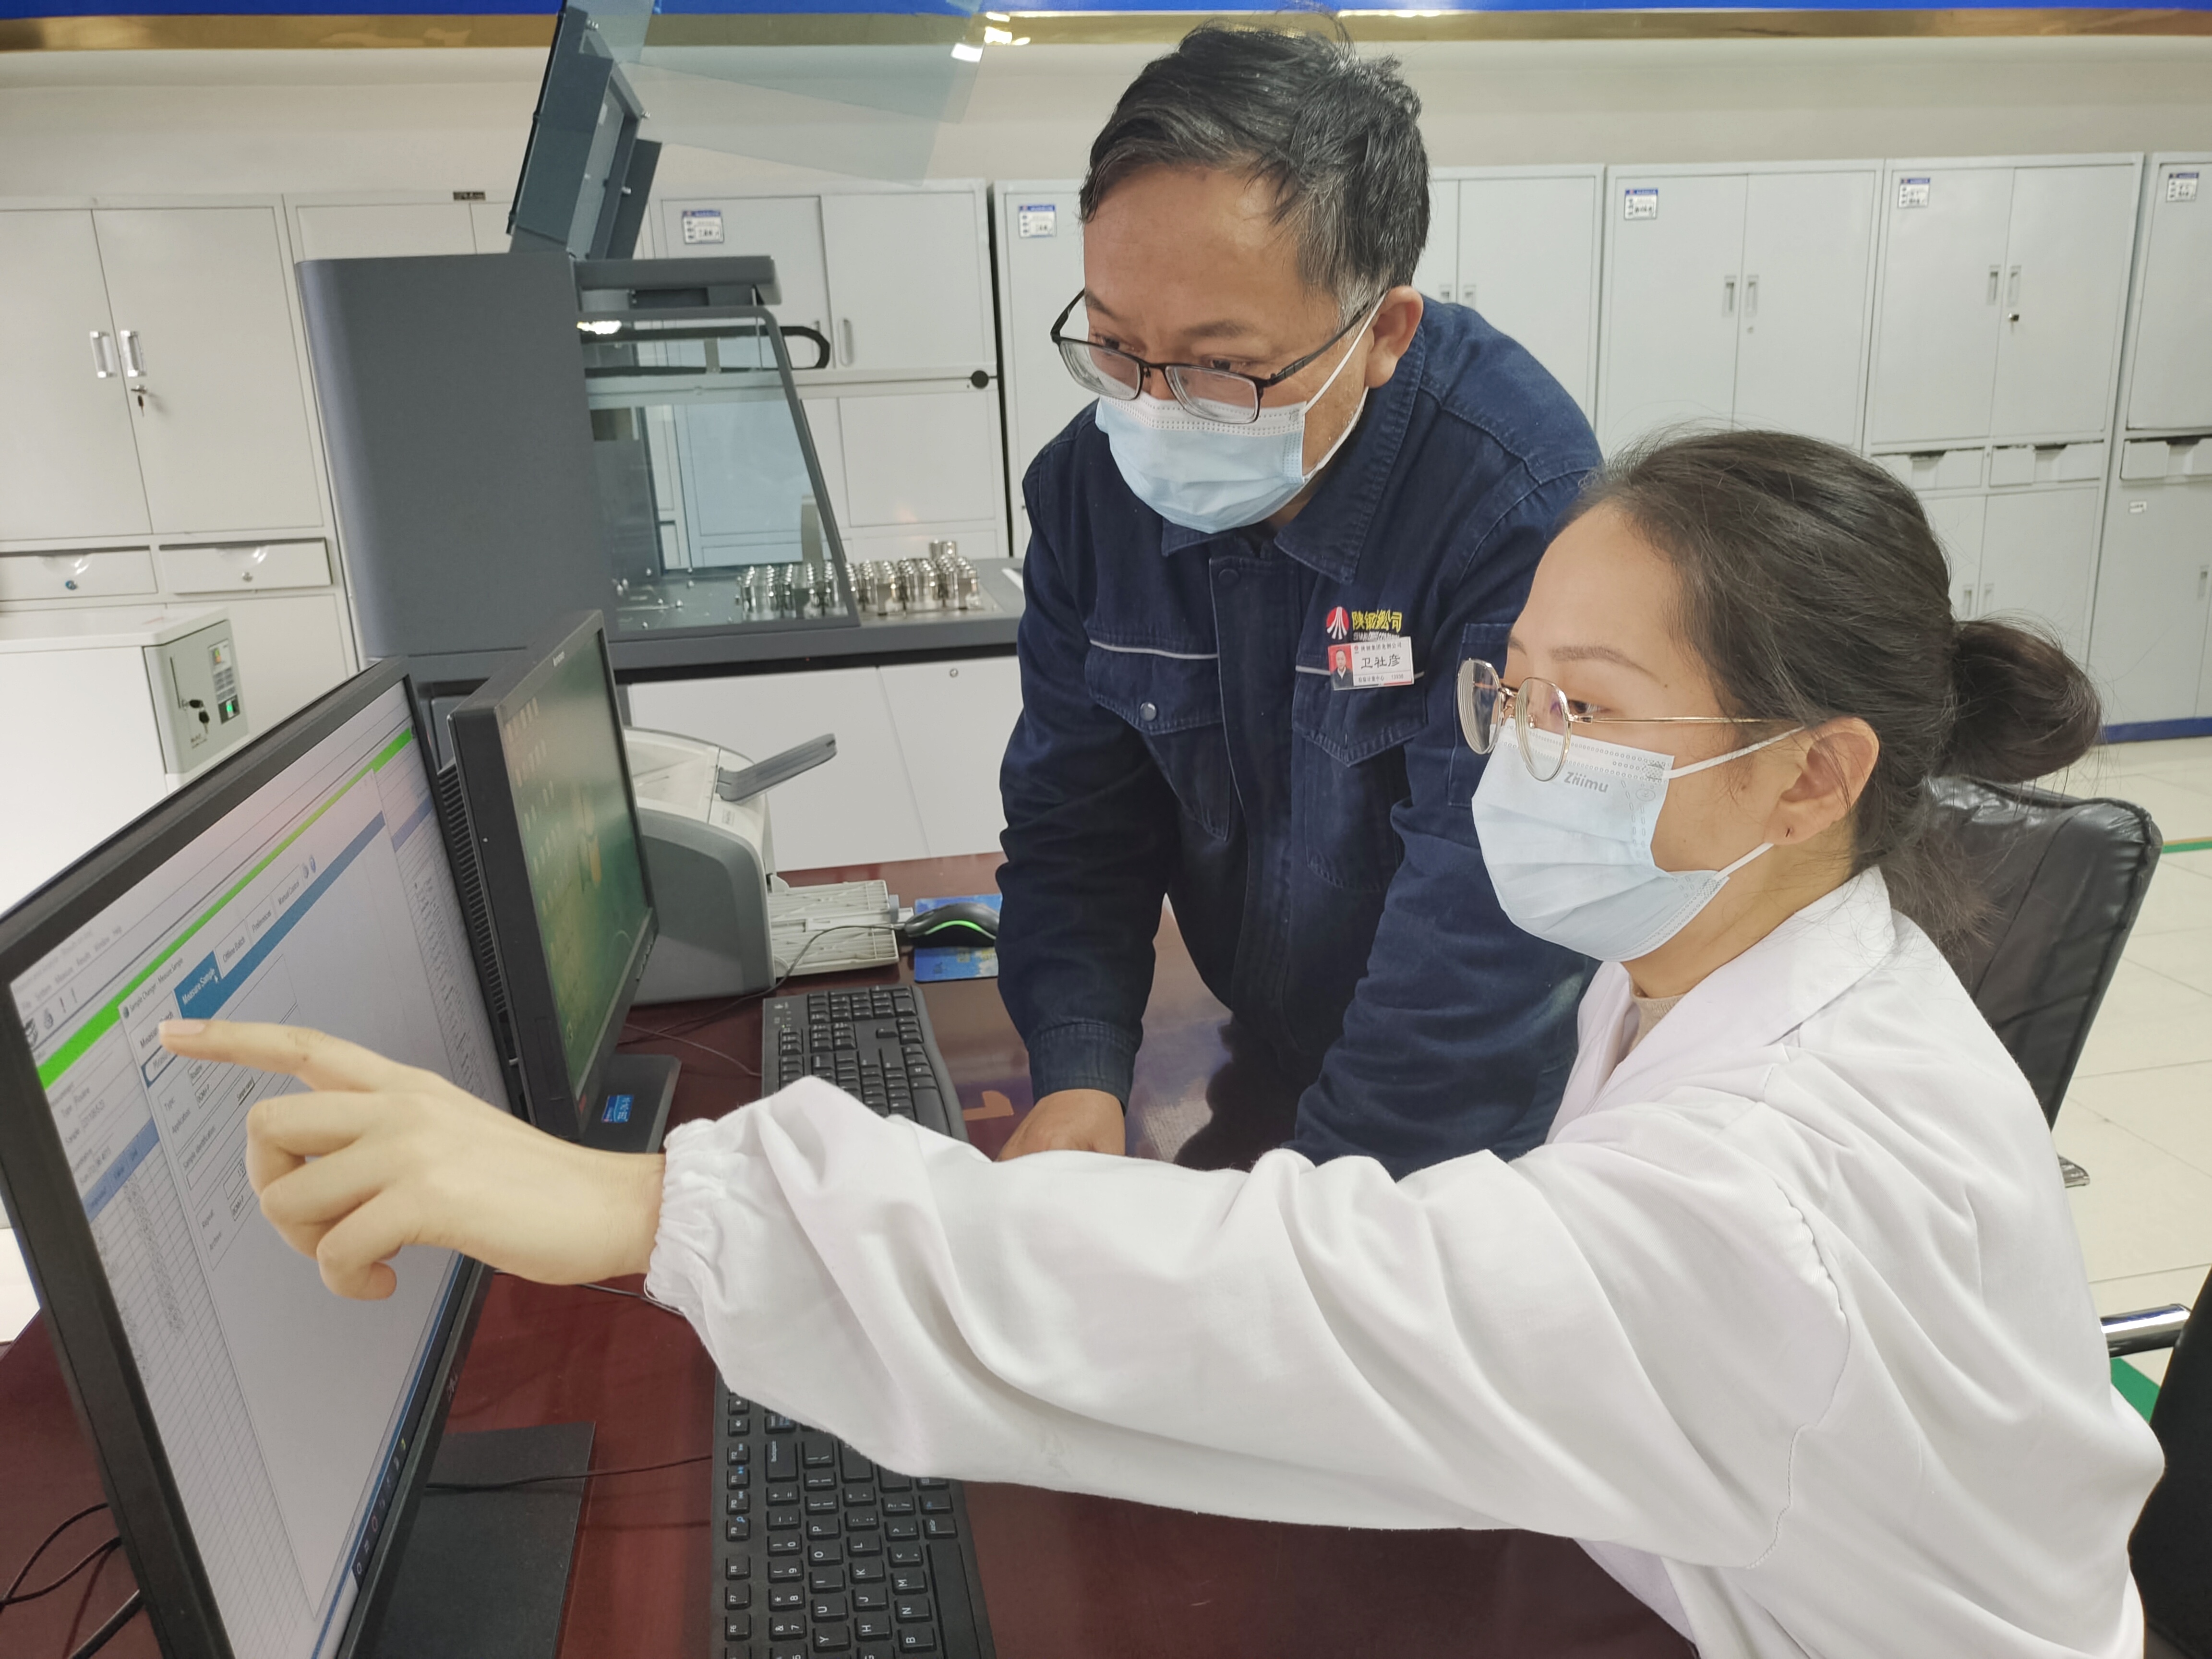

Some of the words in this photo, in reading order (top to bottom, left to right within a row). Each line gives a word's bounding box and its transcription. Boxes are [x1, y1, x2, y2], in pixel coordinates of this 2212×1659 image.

[182, 984, 201, 1006] Measure
[897, 1578, 908, 1587] M
[861, 1624, 872, 1633] H
